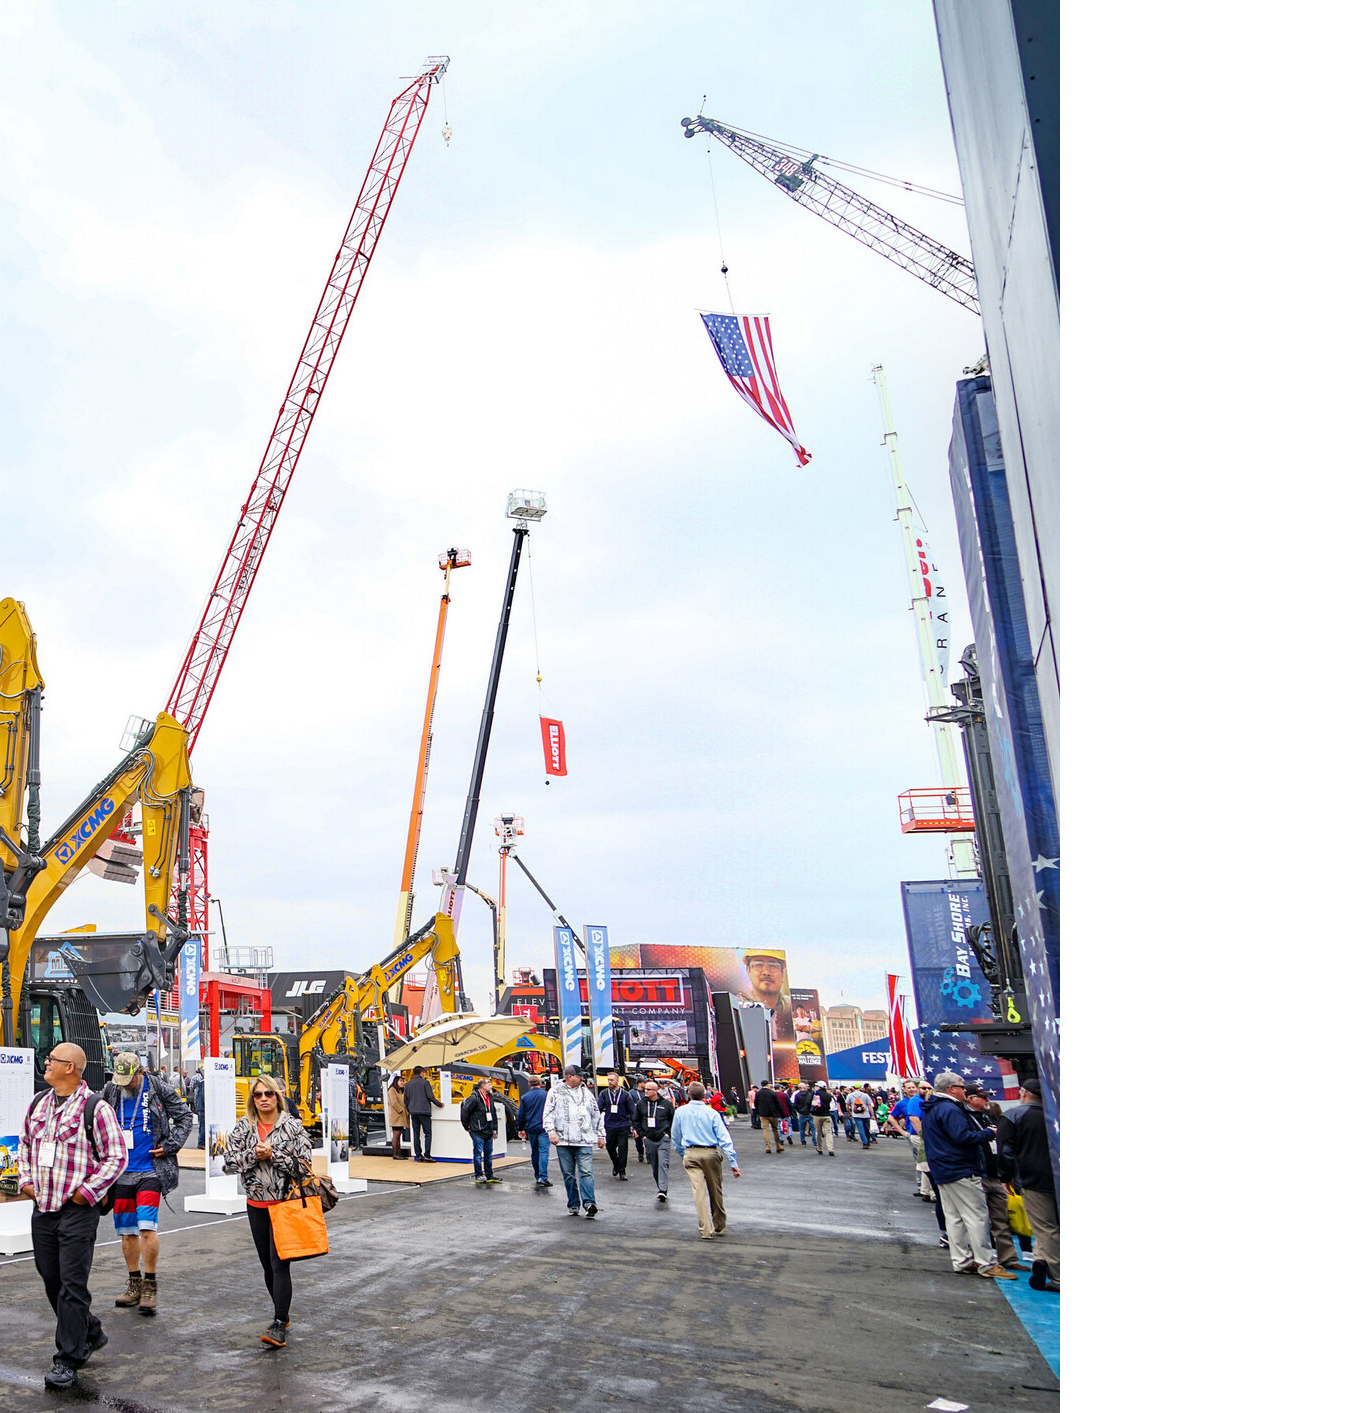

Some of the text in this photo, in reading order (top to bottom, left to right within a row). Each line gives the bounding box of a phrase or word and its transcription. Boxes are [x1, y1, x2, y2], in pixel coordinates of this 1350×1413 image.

[69, 797, 115, 853] XCMG
[446, 890, 455, 918] LLIOTT
[948, 893, 967, 944] SHORE
[186, 957, 196, 997] XCMG
[388, 953, 414, 977] XCMG
[562, 944, 576, 992] XCMG
[594, 944, 606, 992] XCMG
[955, 945, 972, 978] BAY
[285, 980, 327, 998] JLG
[631, 1007, 686, 1015] COMPANY
